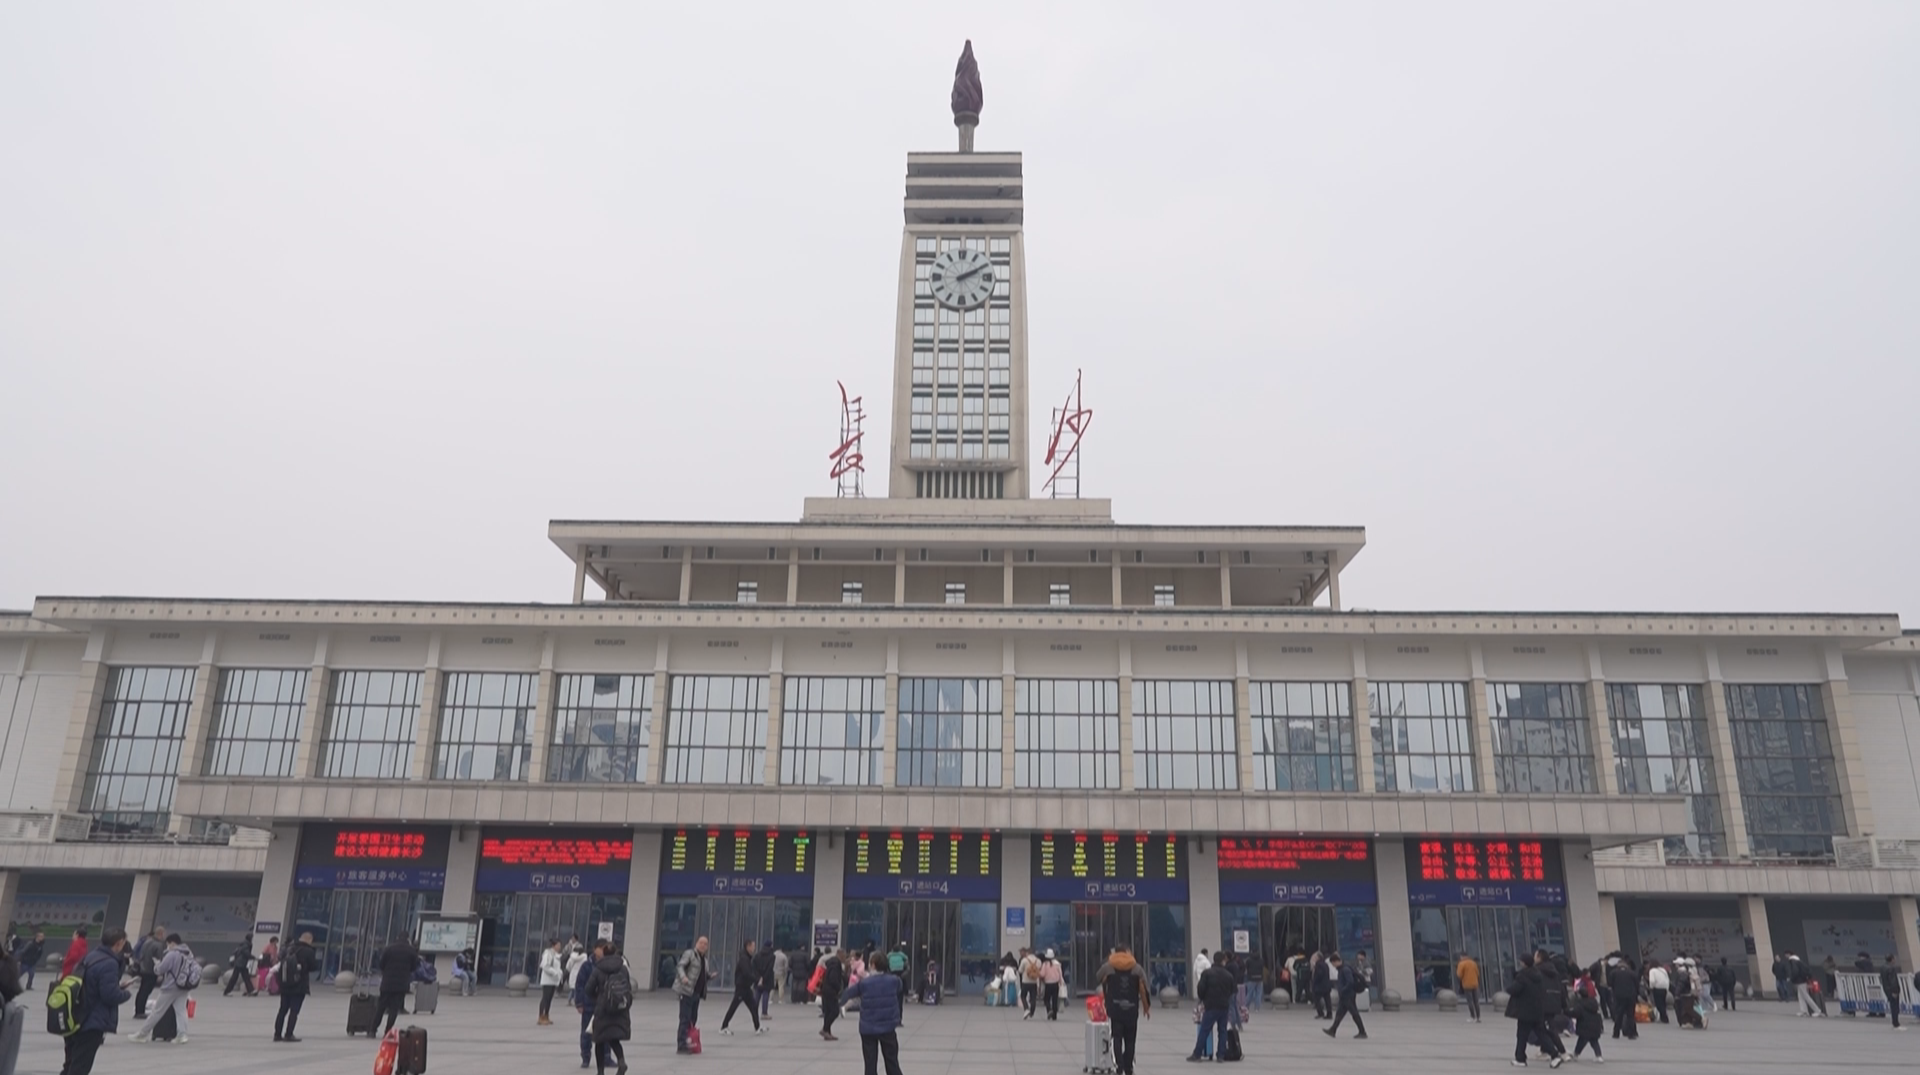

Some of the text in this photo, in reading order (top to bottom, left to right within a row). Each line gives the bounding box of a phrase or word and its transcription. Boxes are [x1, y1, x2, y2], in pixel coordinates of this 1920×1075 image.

[336, 831, 425, 845] 开展爱国卫生运动
[334, 845, 423, 858] 建设文明健康长沙
[347, 869, 407, 881] 旅客服务中心
